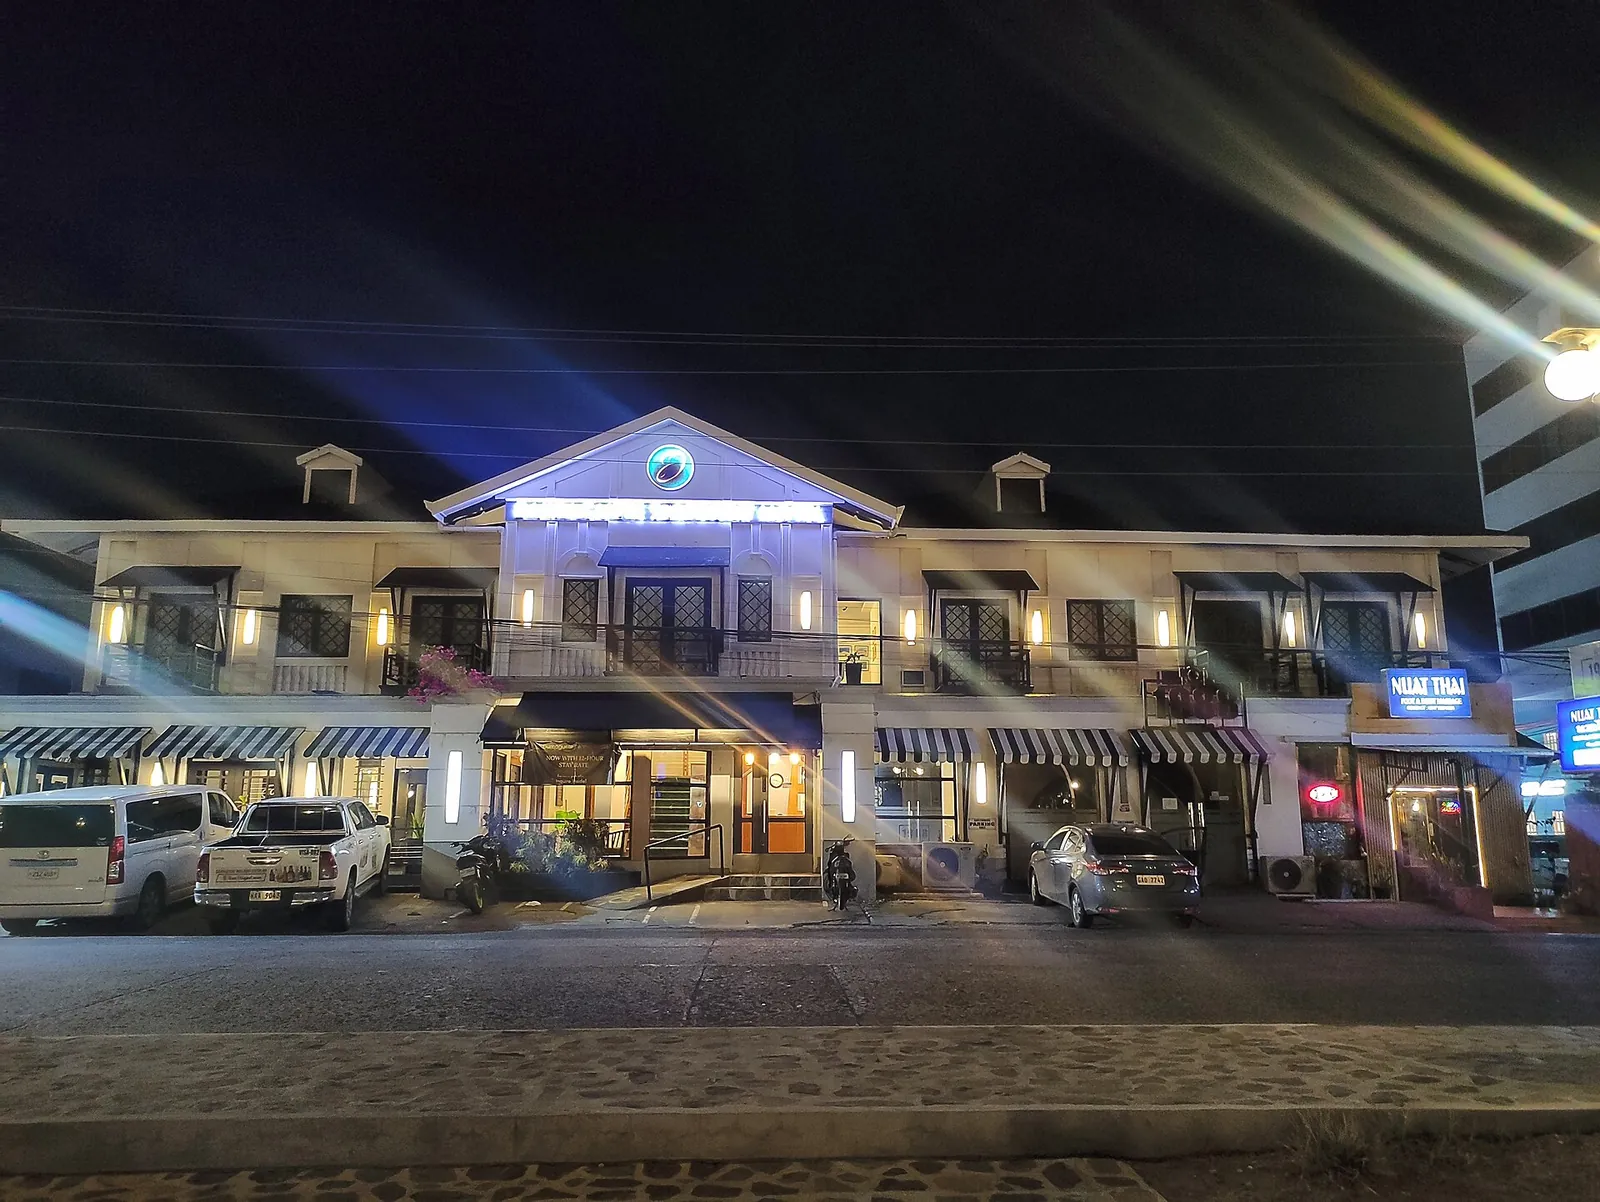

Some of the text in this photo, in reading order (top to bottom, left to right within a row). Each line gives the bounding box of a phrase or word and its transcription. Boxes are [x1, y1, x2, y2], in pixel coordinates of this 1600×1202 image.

[1391, 676, 1466, 696] NUAT THAI
[1570, 708, 1595, 722] NUAT
